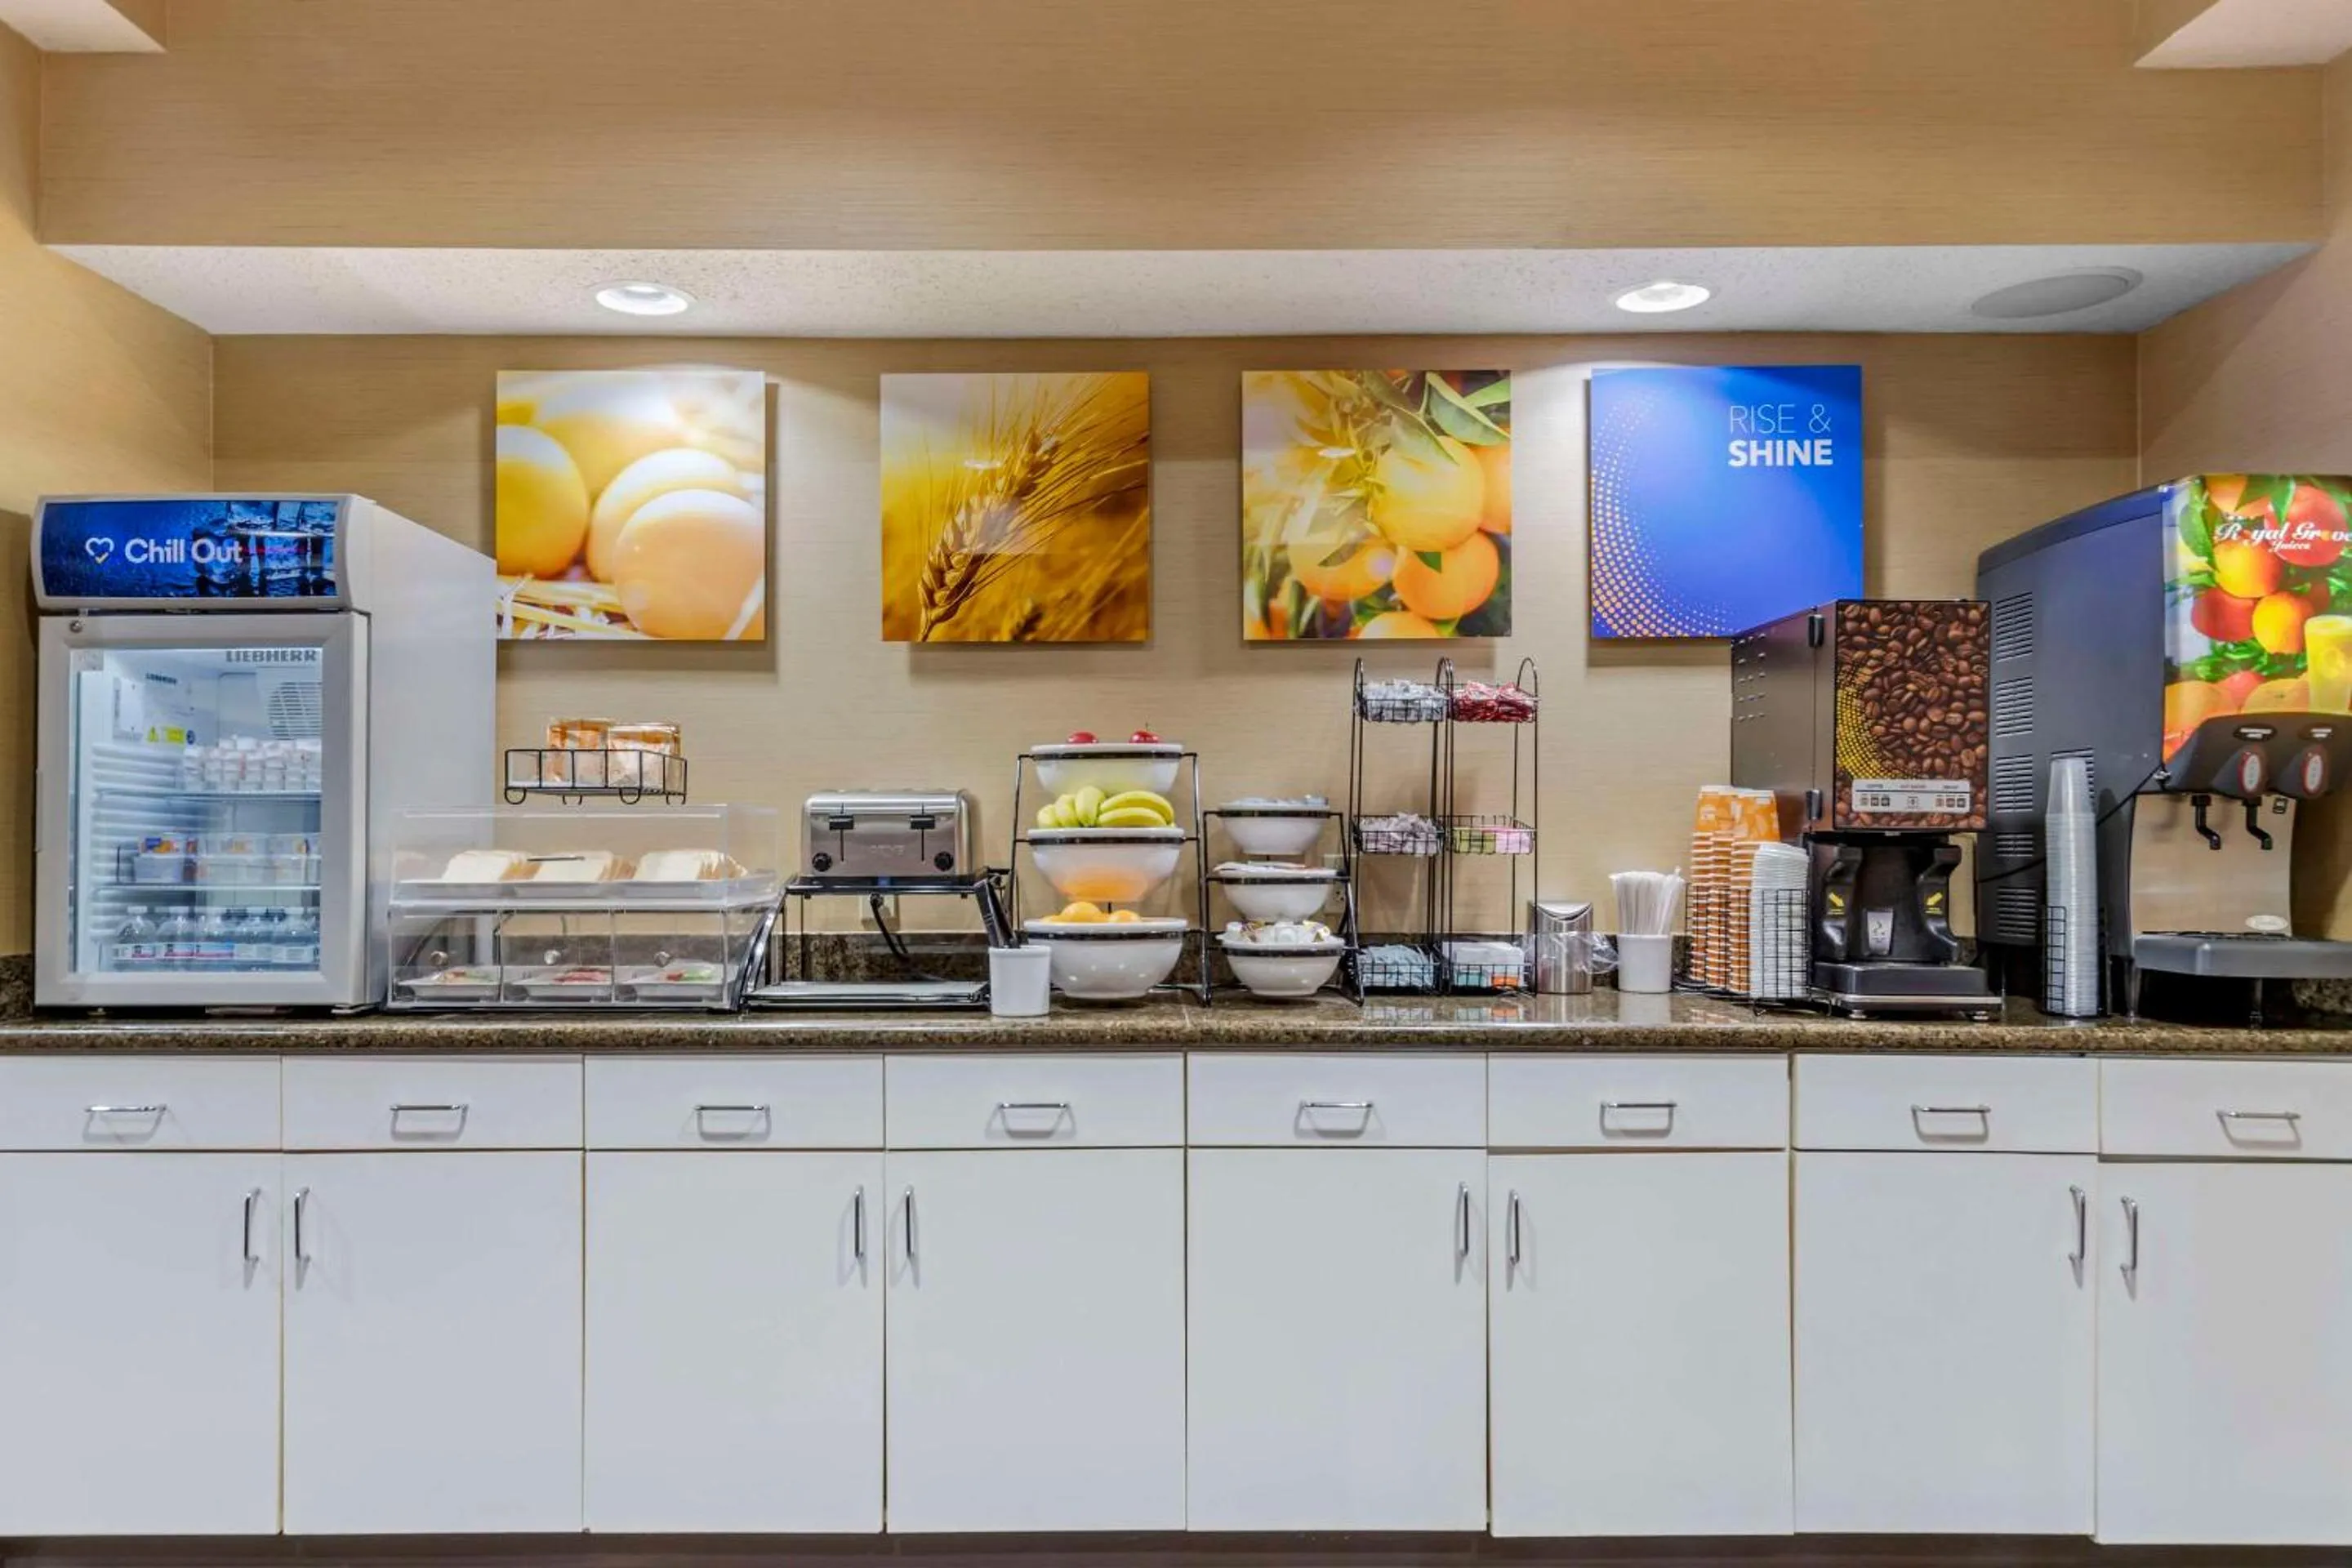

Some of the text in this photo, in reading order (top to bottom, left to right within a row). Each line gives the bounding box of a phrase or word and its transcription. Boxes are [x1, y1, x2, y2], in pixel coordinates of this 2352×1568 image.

[1730, 403, 1832, 434] RISE &
[1728, 439, 1833, 467] SHINE
[124, 537, 243, 564] Chill Out
[225, 649, 317, 662] LIEBHERR
